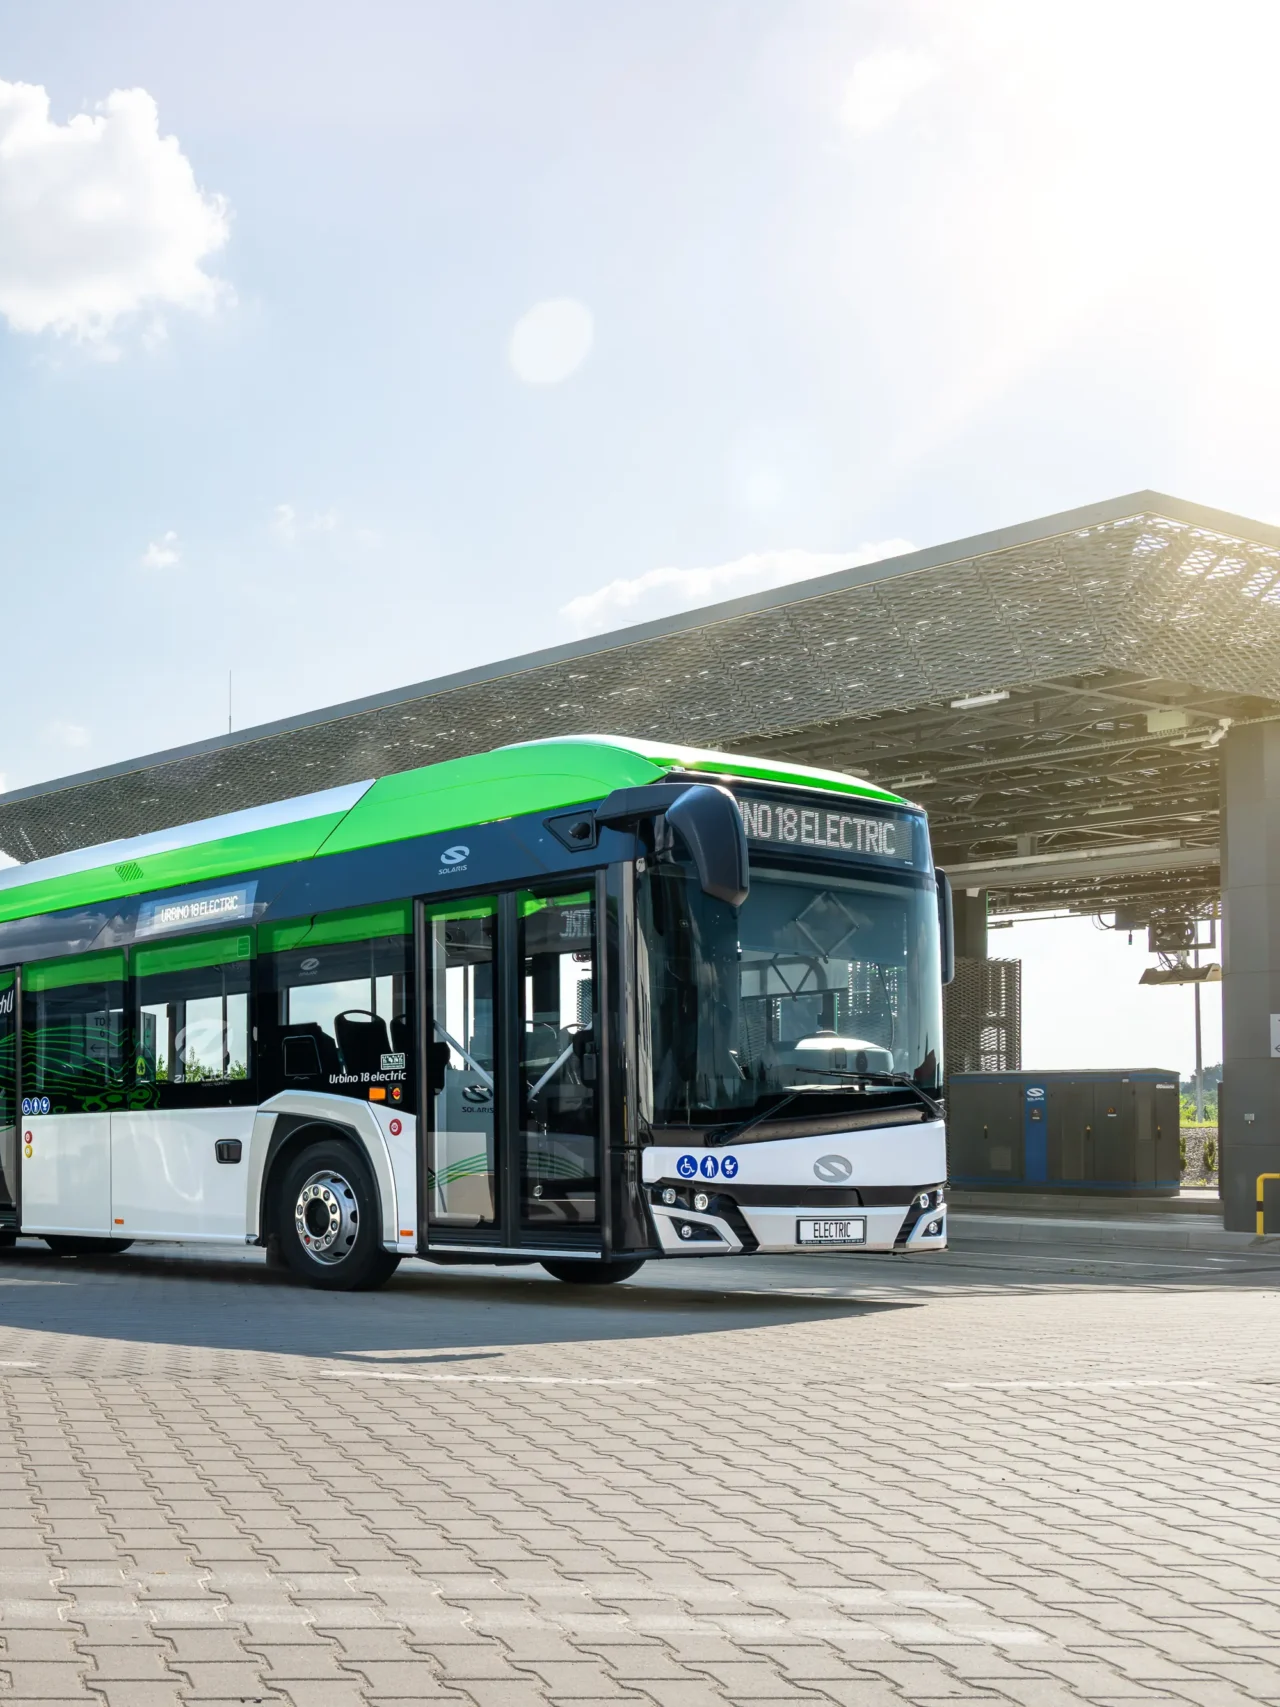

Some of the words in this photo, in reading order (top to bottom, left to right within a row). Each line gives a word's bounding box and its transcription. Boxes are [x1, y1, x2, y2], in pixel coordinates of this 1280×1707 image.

[738, 801, 772, 838] INO
[775, 806, 798, 842] 18
[800, 811, 896, 855] ELECTRIC
[438, 864, 468, 875] SOLARIS
[161, 905, 189, 922] URBINO
[190, 903, 199, 917] 18
[200, 896, 238, 915] ELECTRIC
[329, 1073, 358, 1084] Urbino
[360, 1072, 370, 1082] 18
[371, 1070, 407, 1081] electric
[461, 1106, 495, 1114] SOLARIS
[813, 1222, 851, 1238] ELECTRIC
